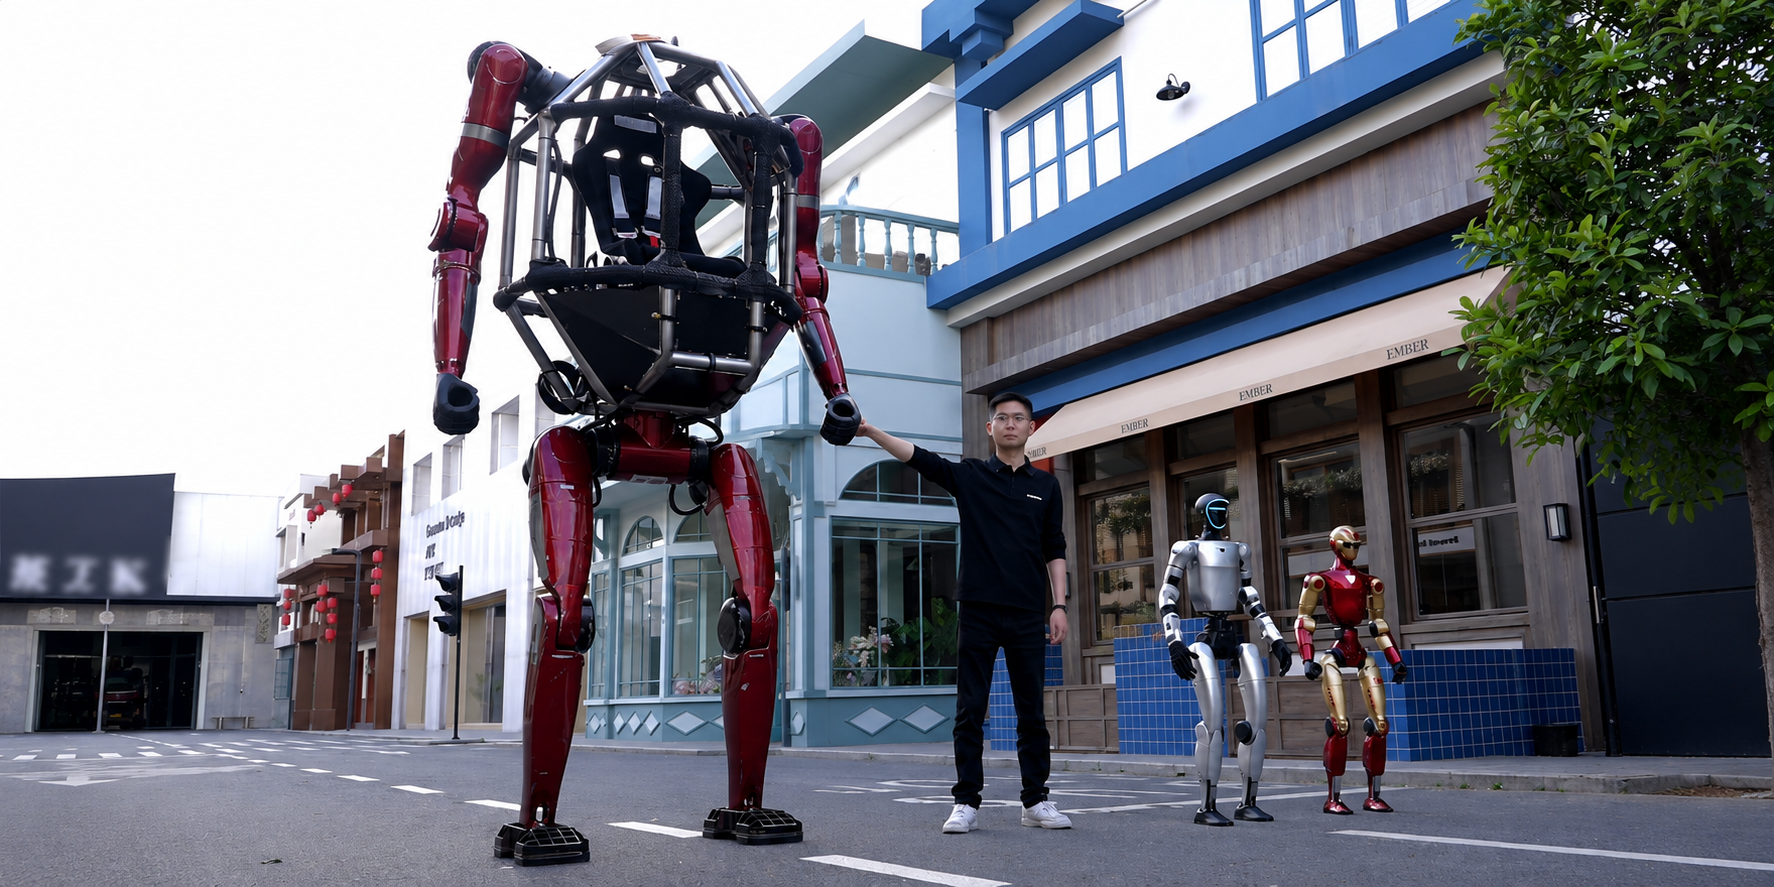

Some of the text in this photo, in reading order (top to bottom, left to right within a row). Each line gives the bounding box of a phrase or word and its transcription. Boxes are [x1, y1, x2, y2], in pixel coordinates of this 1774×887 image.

[1386, 339, 1429, 360] EMBER
[1239, 383, 1273, 401] EMBER
[1121, 418, 1149, 433] EMBER
